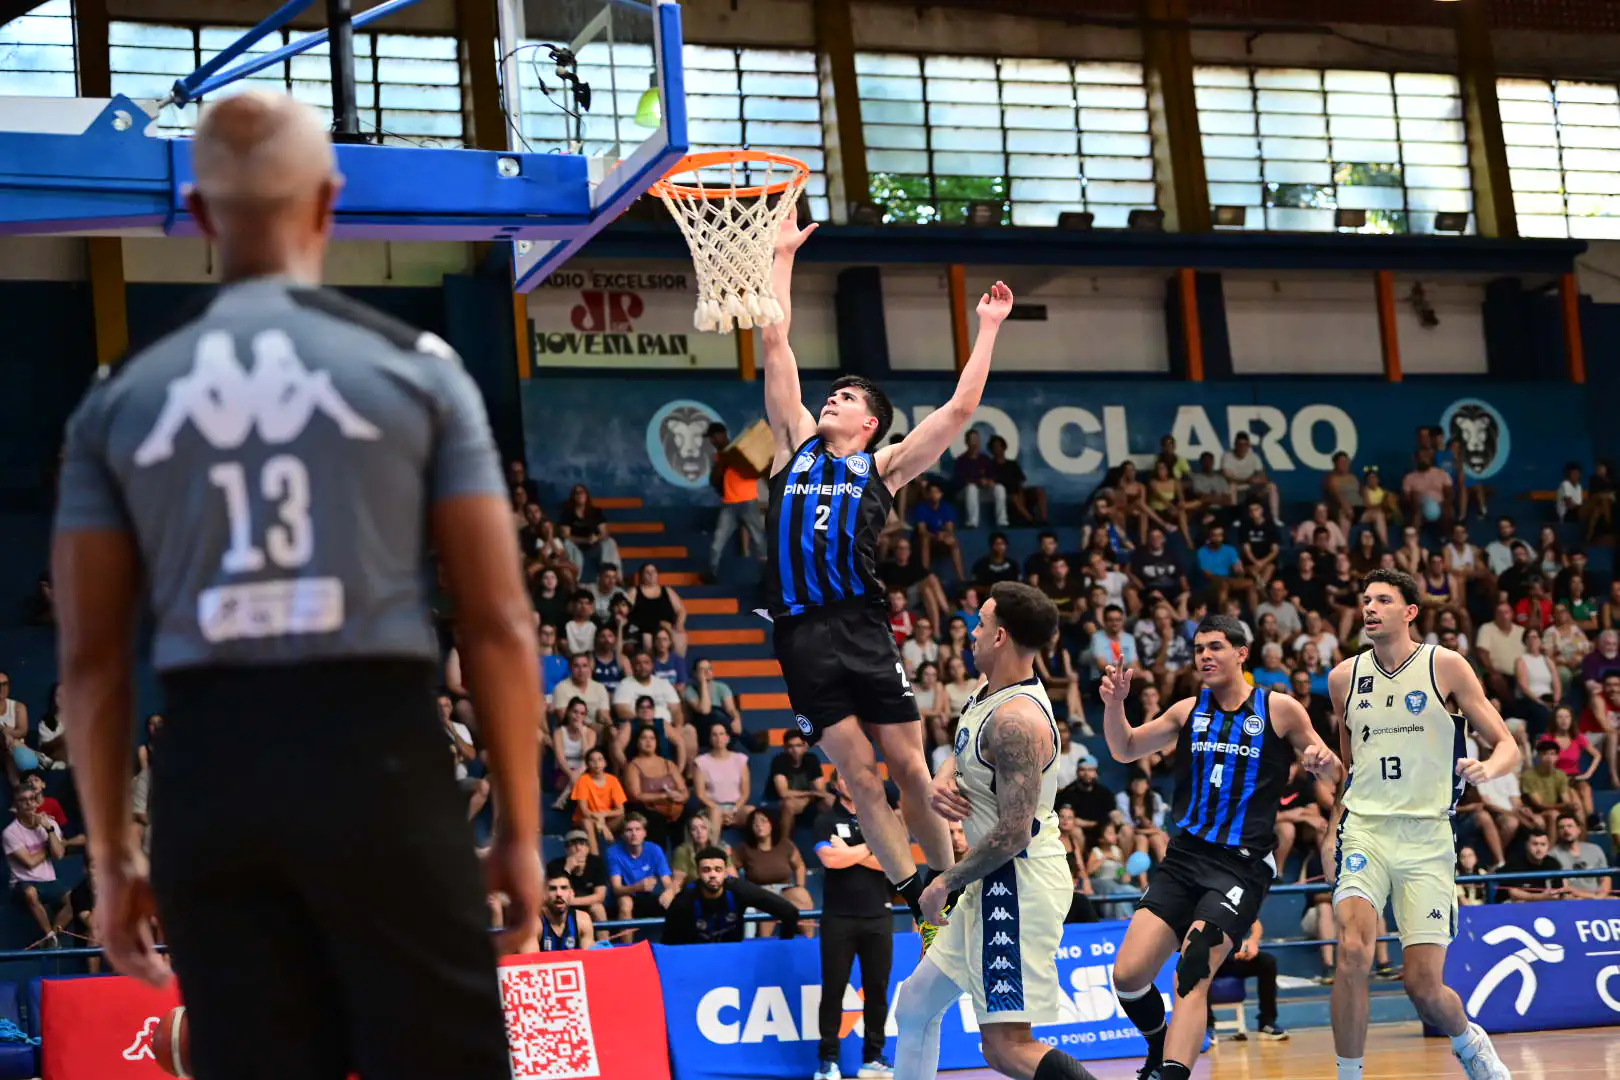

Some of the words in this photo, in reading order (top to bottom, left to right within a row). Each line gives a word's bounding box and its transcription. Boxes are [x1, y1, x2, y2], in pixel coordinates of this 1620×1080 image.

[593, 273, 687, 288] EXCELSIOR
[536, 332, 634, 354] JOVEM
[637, 333, 688, 355] PAN
[1037, 403, 1358, 475] CLARO
[783, 482, 863, 499] PINHEIROS
[207, 453, 315, 574] 13
[813, 504, 831, 531] 2
[1191, 741, 1261, 759] PINHEIROS
[1209, 763, 1224, 788] 4
[1379, 756, 1402, 780] 13
[1225, 885, 1244, 906] 4
[1090, 941, 1116, 956] DO
[1061, 1031, 1096, 1045] POVO
